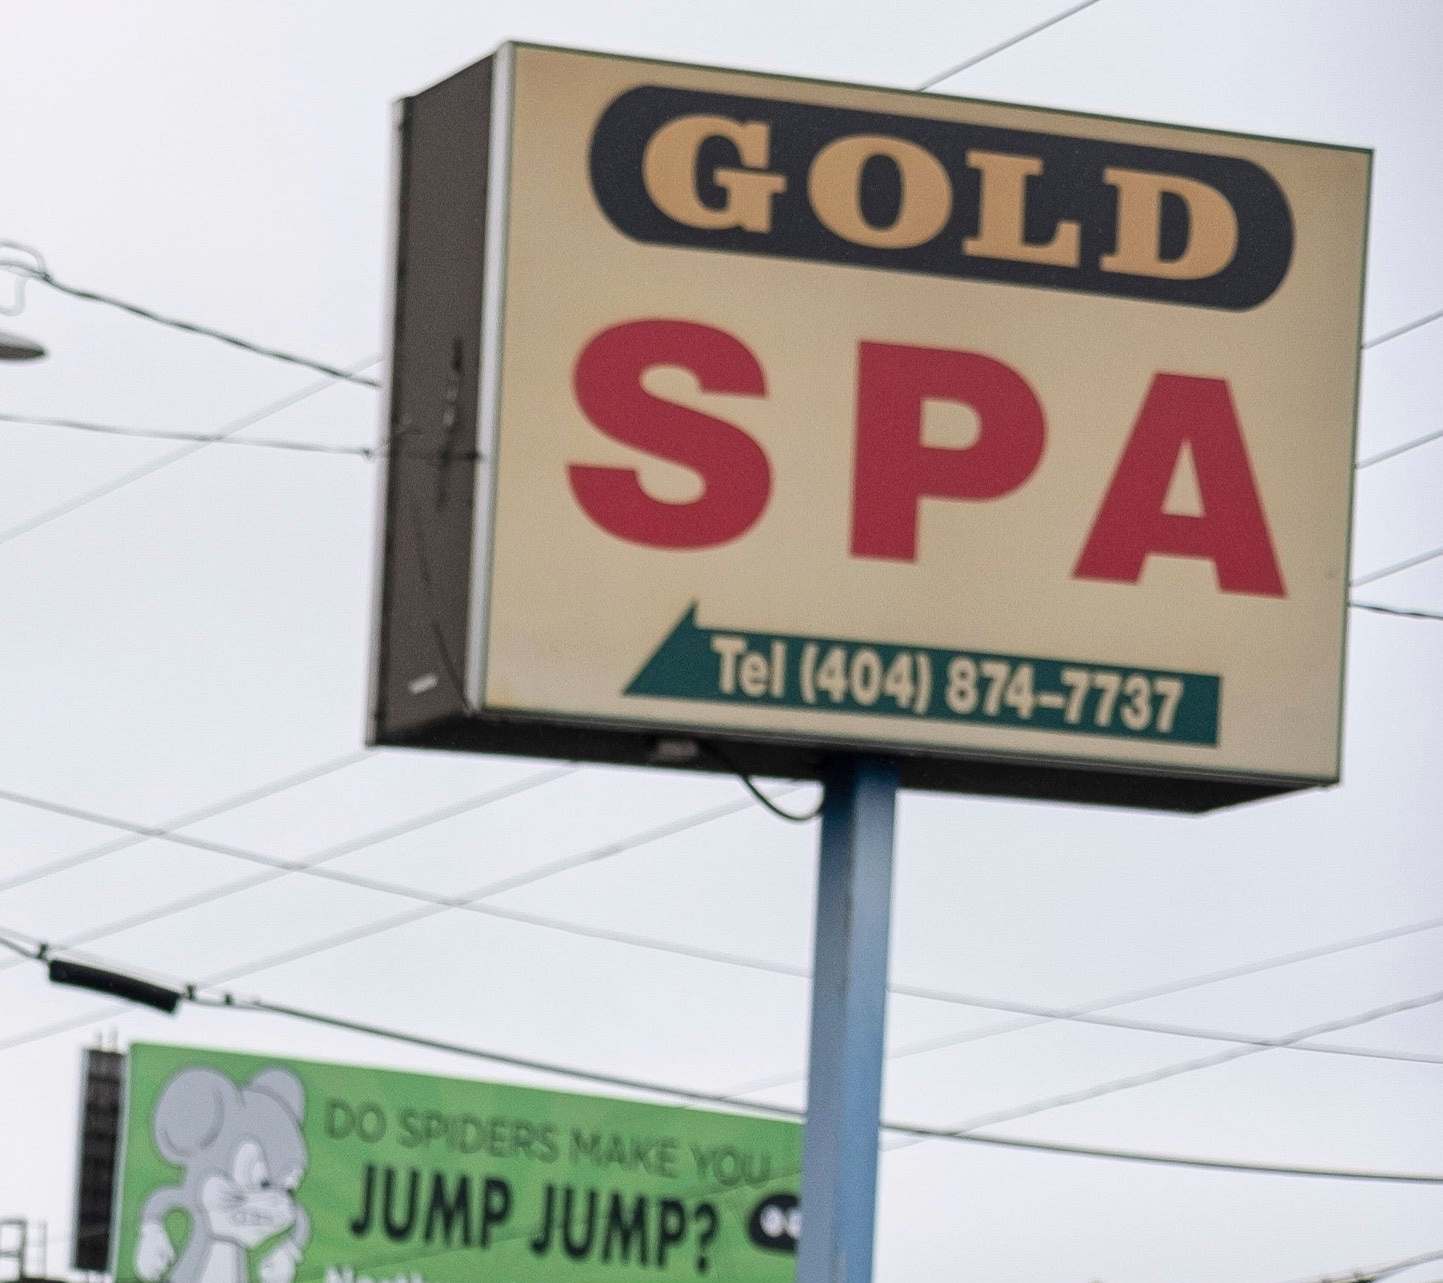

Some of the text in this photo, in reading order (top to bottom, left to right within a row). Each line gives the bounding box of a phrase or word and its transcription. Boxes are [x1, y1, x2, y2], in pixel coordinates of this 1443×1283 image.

[642, 115, 1239, 281] GOLD
[566, 317, 1287, 599] SPA
[711, 635, 1184, 733] Tel (404) 874-7737
[325, 1099, 773, 1187] DO SPIDERS MAKE YOU
[349, 1164, 719, 1274] JUMP JUMP?
